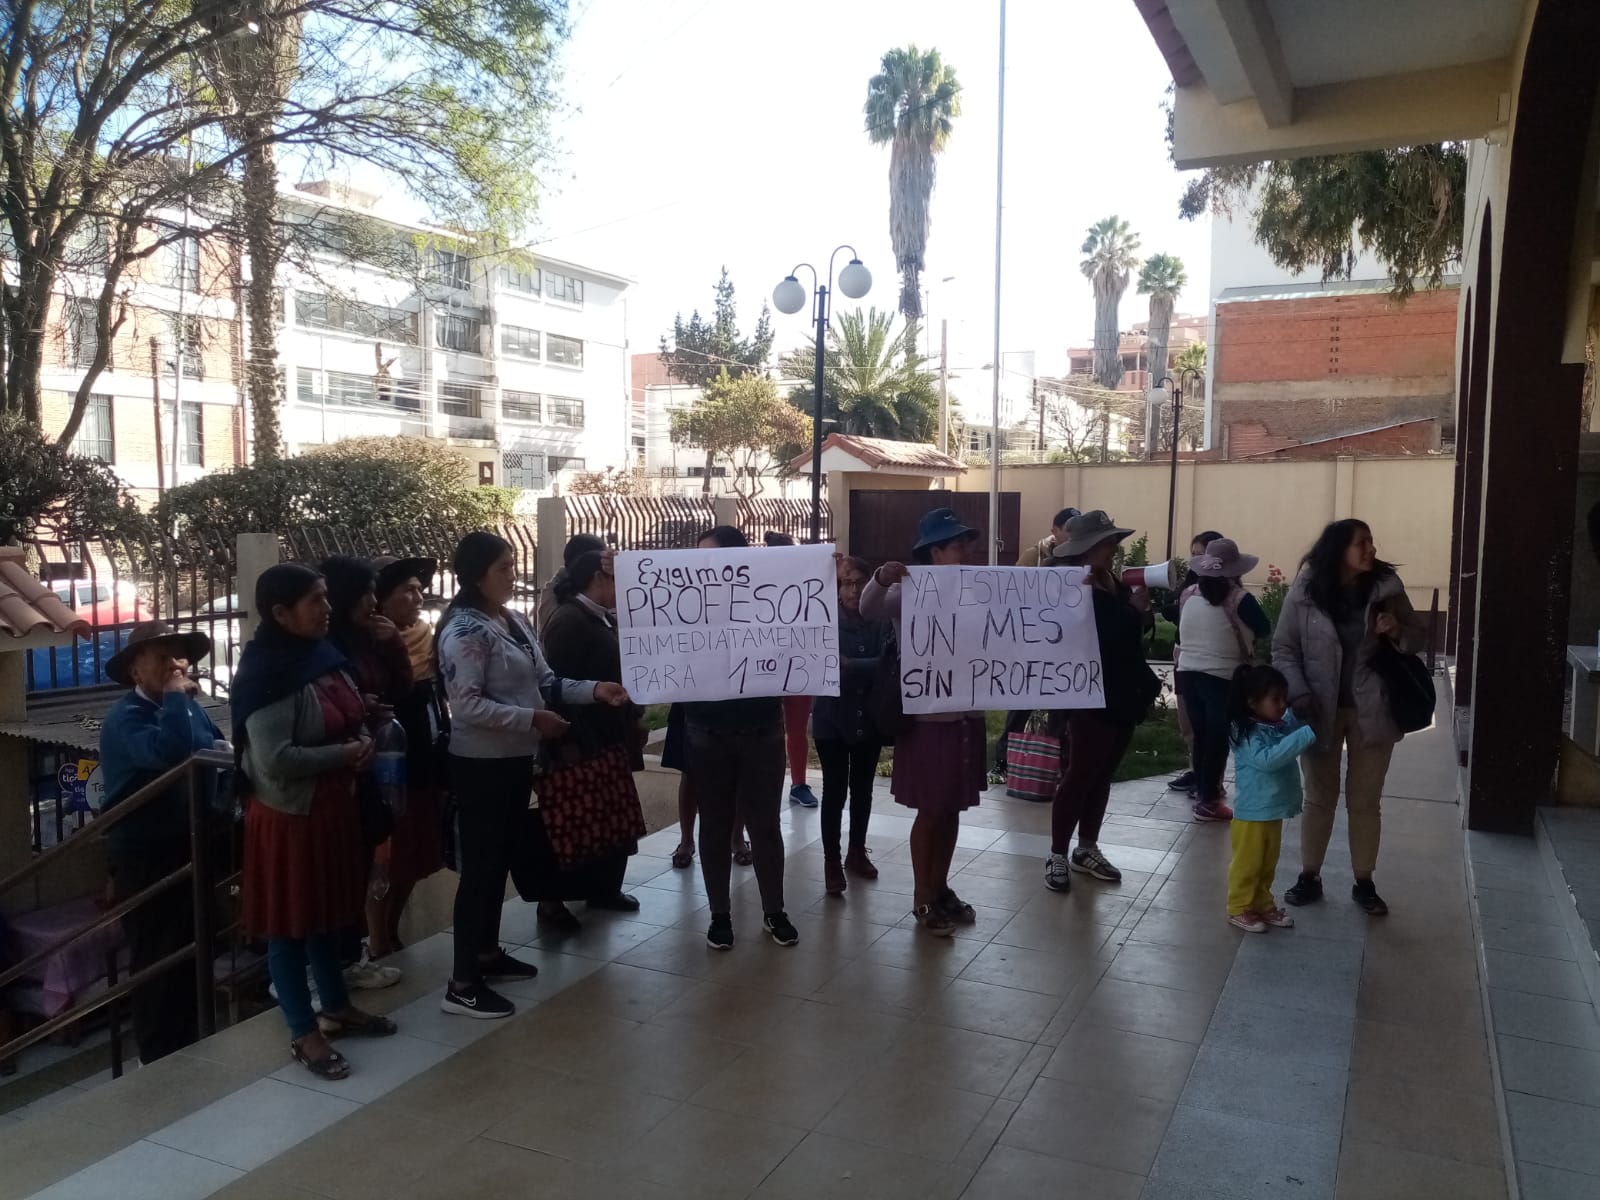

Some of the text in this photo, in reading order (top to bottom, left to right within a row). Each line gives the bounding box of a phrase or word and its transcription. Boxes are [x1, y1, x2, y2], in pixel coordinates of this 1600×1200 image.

[626, 579, 831, 628] PROFESOR
[909, 569, 1083, 608] YA ESTAMOS
[623, 625, 838, 656] INMEDIATAMENTE
[910, 606, 1064, 656] UN MES
[630, 664, 696, 692] PARA
[967, 658, 1102, 707] PROFESOR
